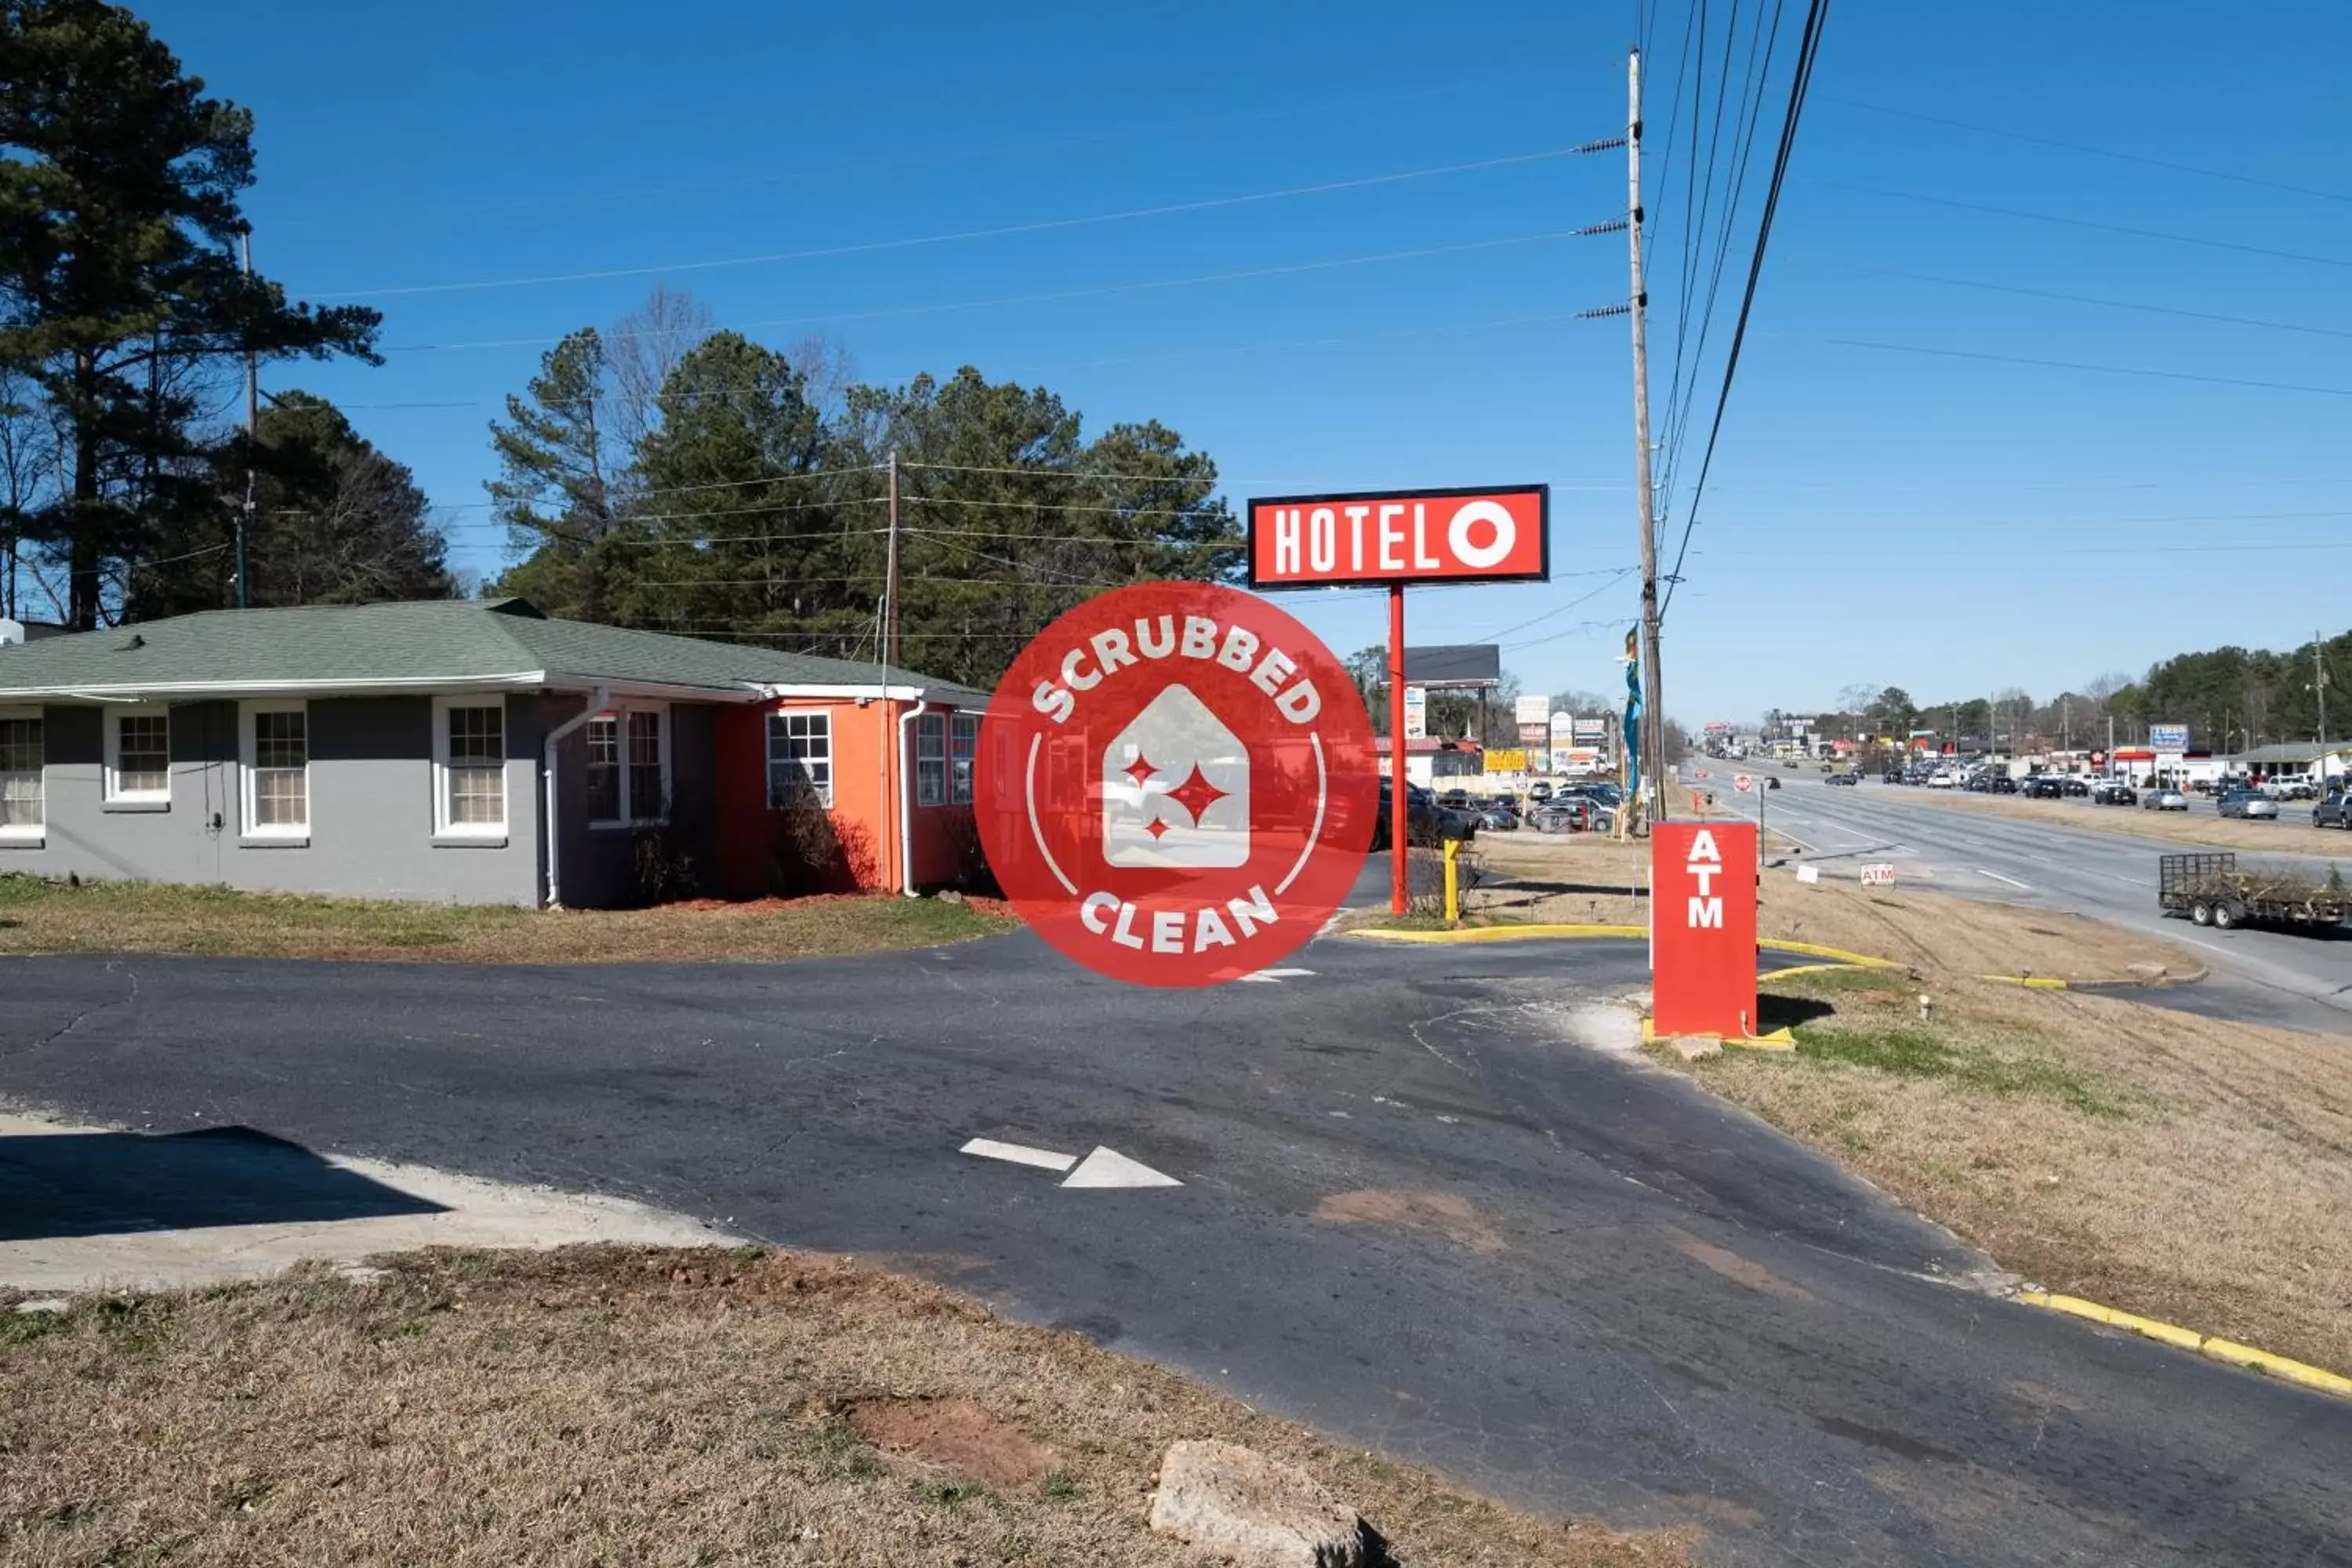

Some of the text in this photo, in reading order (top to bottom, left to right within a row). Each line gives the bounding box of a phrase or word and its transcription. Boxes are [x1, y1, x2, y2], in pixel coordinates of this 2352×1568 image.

[1275, 500, 1516, 574] HOTEL O
[1686, 829, 1722, 928] ATM
[1863, 869, 1893, 880] ATM
